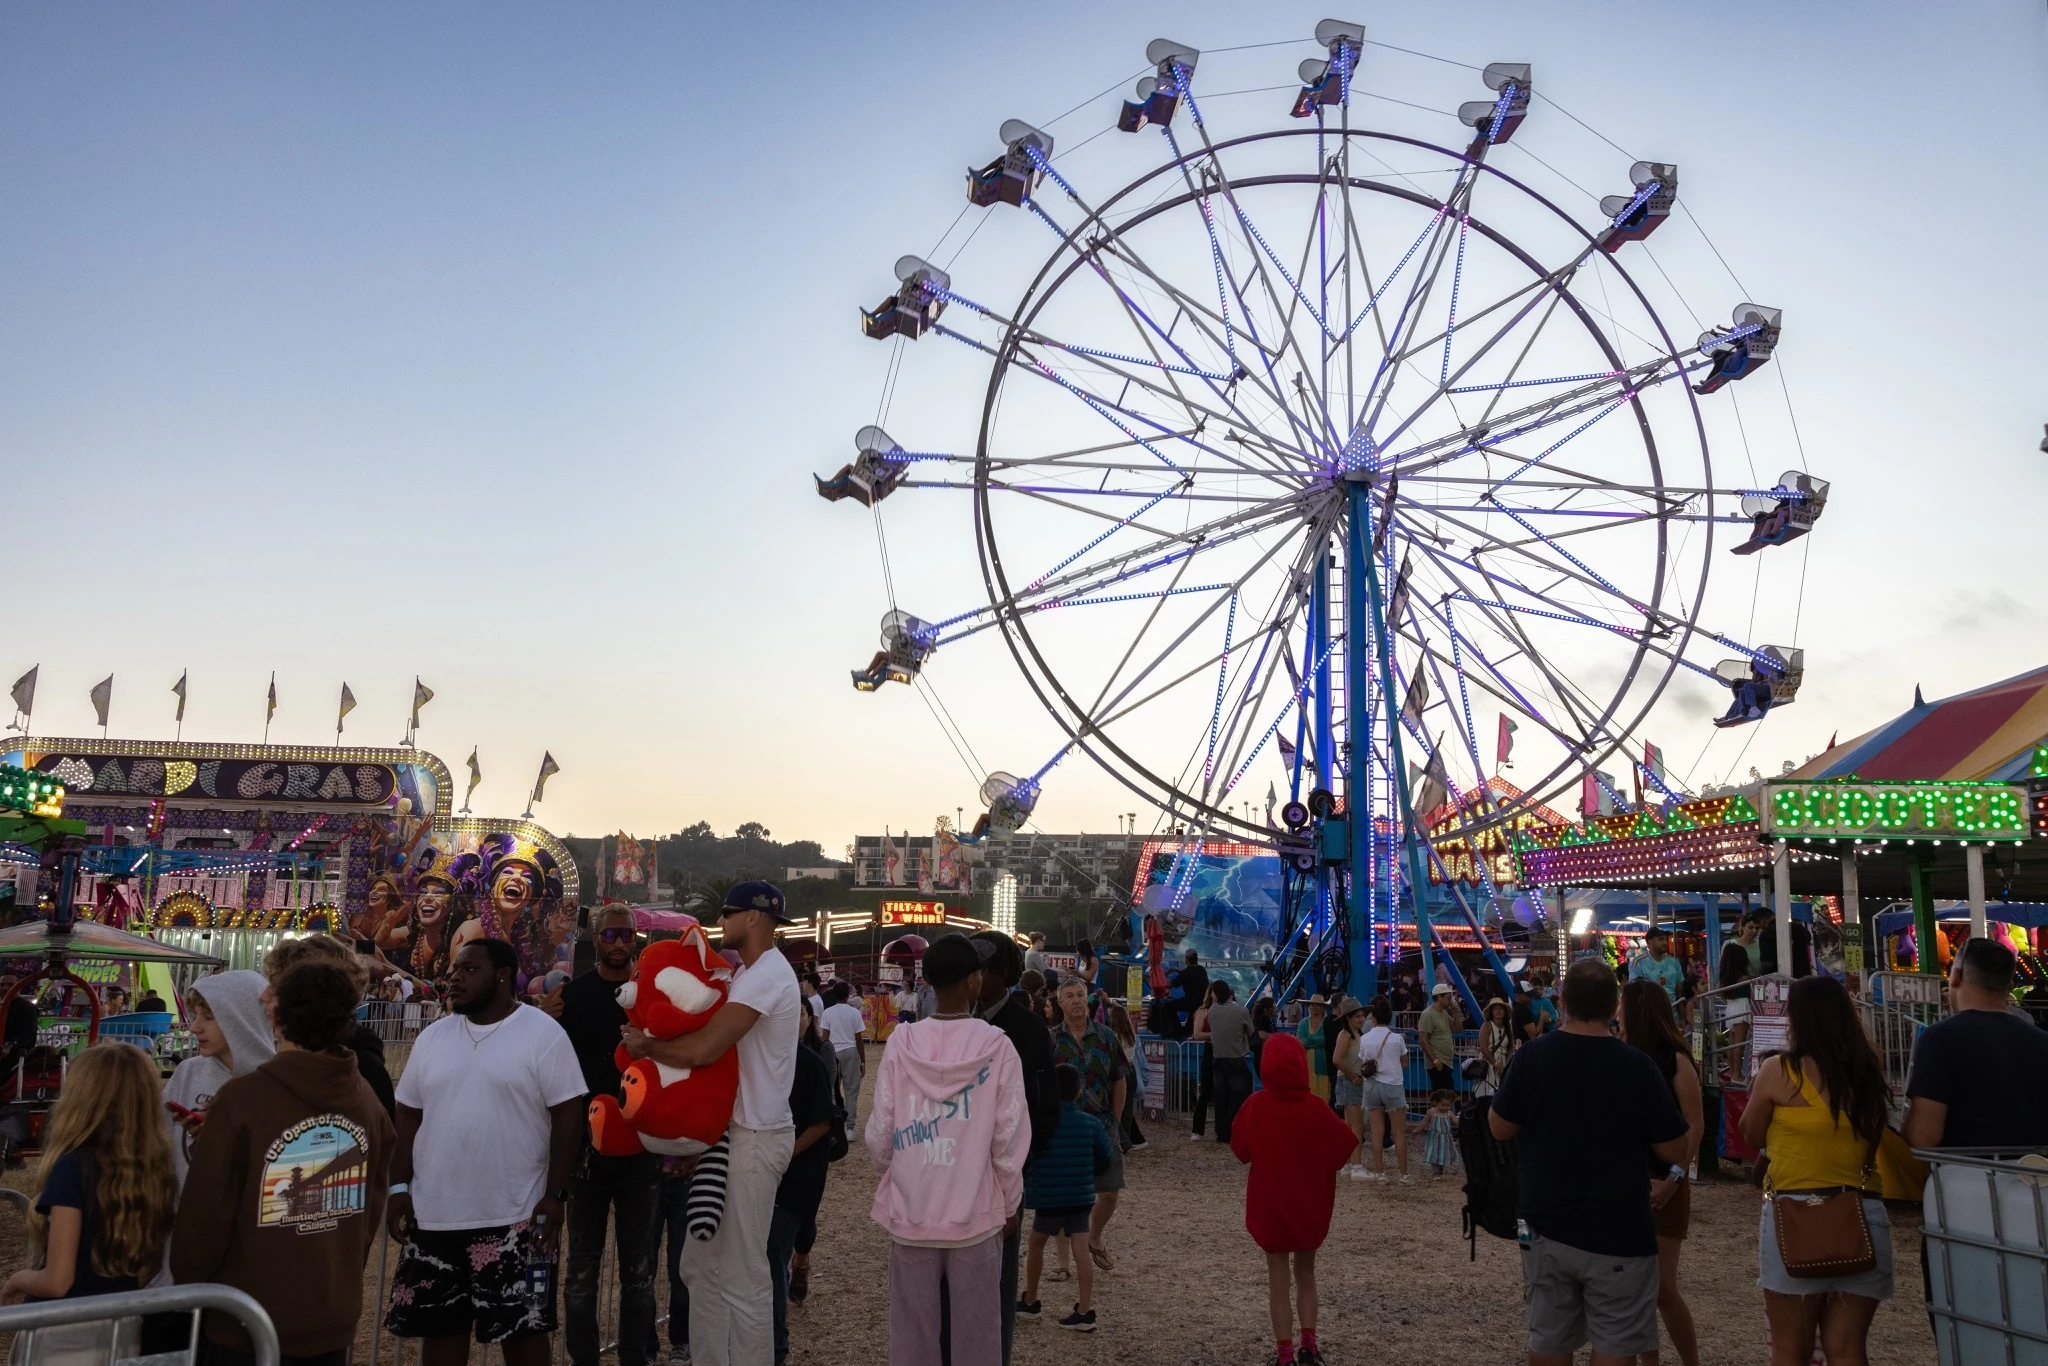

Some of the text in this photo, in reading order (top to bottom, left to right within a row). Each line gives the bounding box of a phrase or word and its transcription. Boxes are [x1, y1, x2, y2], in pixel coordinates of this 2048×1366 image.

[48, 756, 383, 800] MARDI GRAS
[1774, 789, 2023, 831] SCOOTER
[902, 913, 942, 924] WHIRL
[1845, 928, 1860, 937] GO
[1891, 976, 1930, 1001] EXIT
[283, 1117, 316, 1142] Open
[319, 1113, 332, 1126] of
[333, 1114, 369, 1154] Surfing
[893, 1116, 941, 1151] WITHOUT
[923, 1138, 958, 1167] ME
[299, 1219, 338, 1232] California
